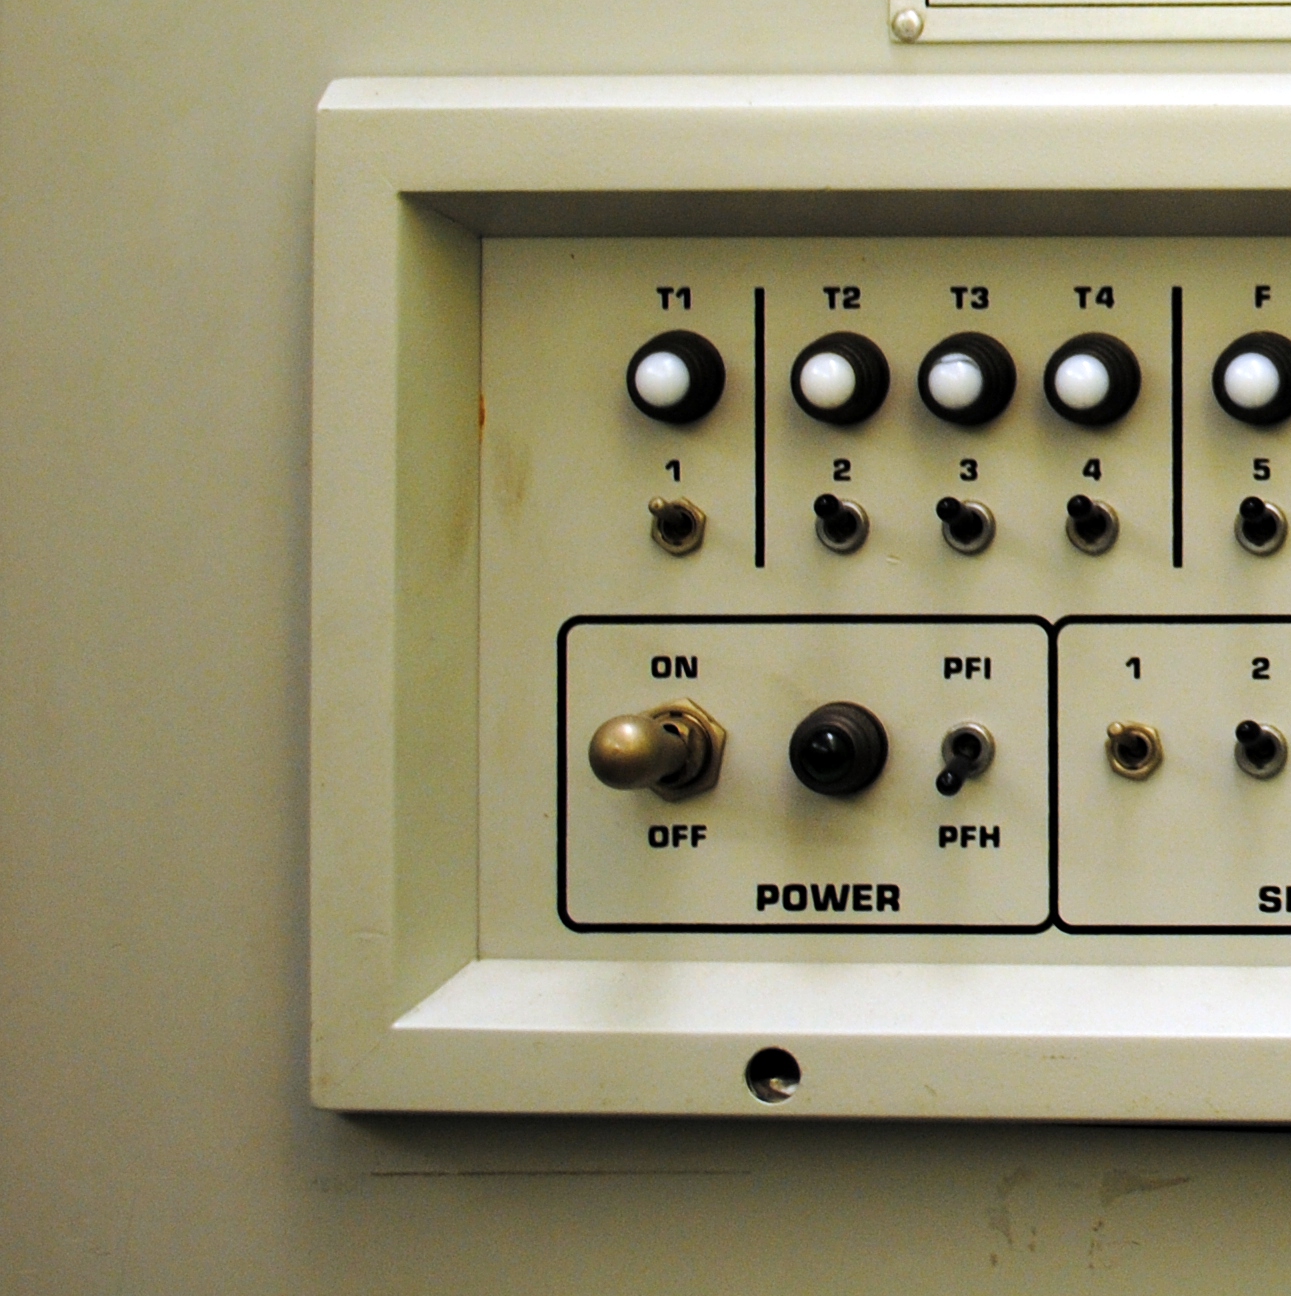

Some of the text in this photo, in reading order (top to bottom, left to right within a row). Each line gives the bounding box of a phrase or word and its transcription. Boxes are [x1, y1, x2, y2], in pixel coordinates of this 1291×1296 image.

[656, 286, 691, 310] T1
[823, 286, 860, 309] T2
[950, 286, 989, 310] T3
[1074, 286, 1114, 309] T4
[1255, 285, 1271, 308] F
[665, 459, 680, 482] 1
[833, 458, 851, 481] 2
[960, 458, 978, 481] 3
[1082, 458, 1101, 481] 4
[1253, 458, 1270, 481] 5
[651, 656, 697, 679] ON
[944, 657, 991, 679] PFI
[1126, 657, 1140, 679] 1
[1252, 657, 1270, 680] 2
[648, 825, 707, 848] OFF
[939, 825, 1000, 848] PFH
[757, 884, 900, 912] POWER
